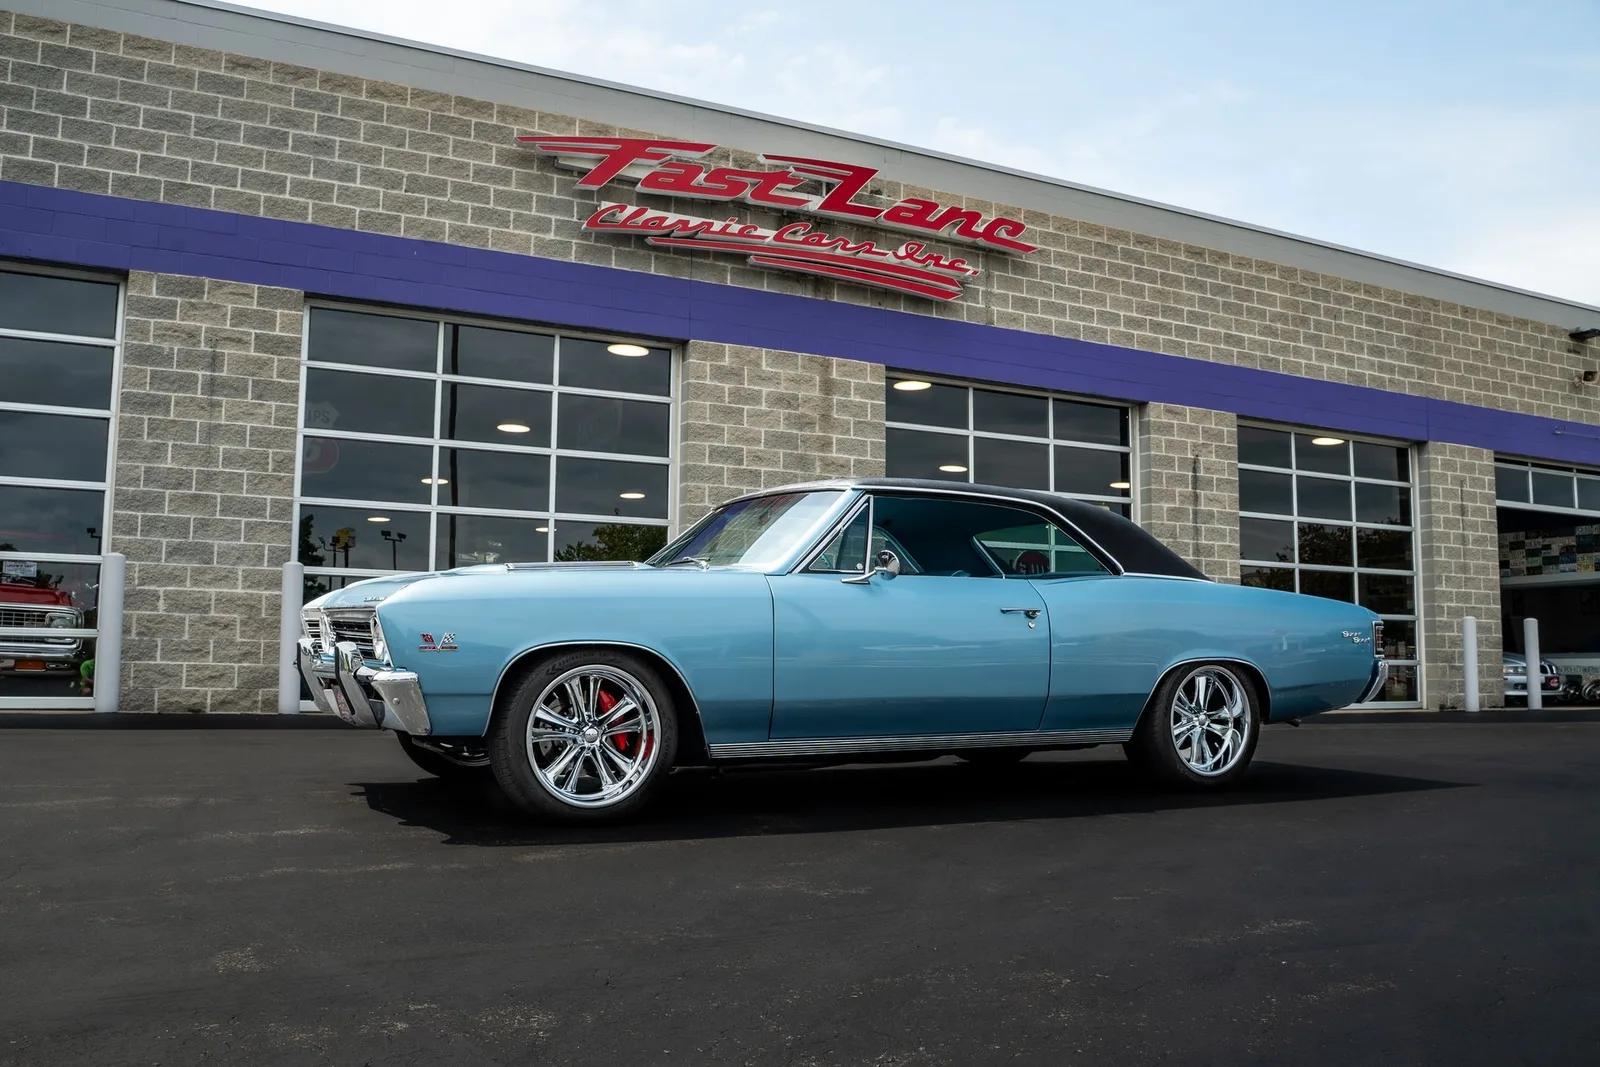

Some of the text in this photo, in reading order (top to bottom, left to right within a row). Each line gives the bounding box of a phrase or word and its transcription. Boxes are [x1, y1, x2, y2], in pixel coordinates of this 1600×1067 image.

[515, 135, 1039, 253] Fast Lane
[583, 203, 771, 241] Classic
[771, 222, 892, 258] Cars
